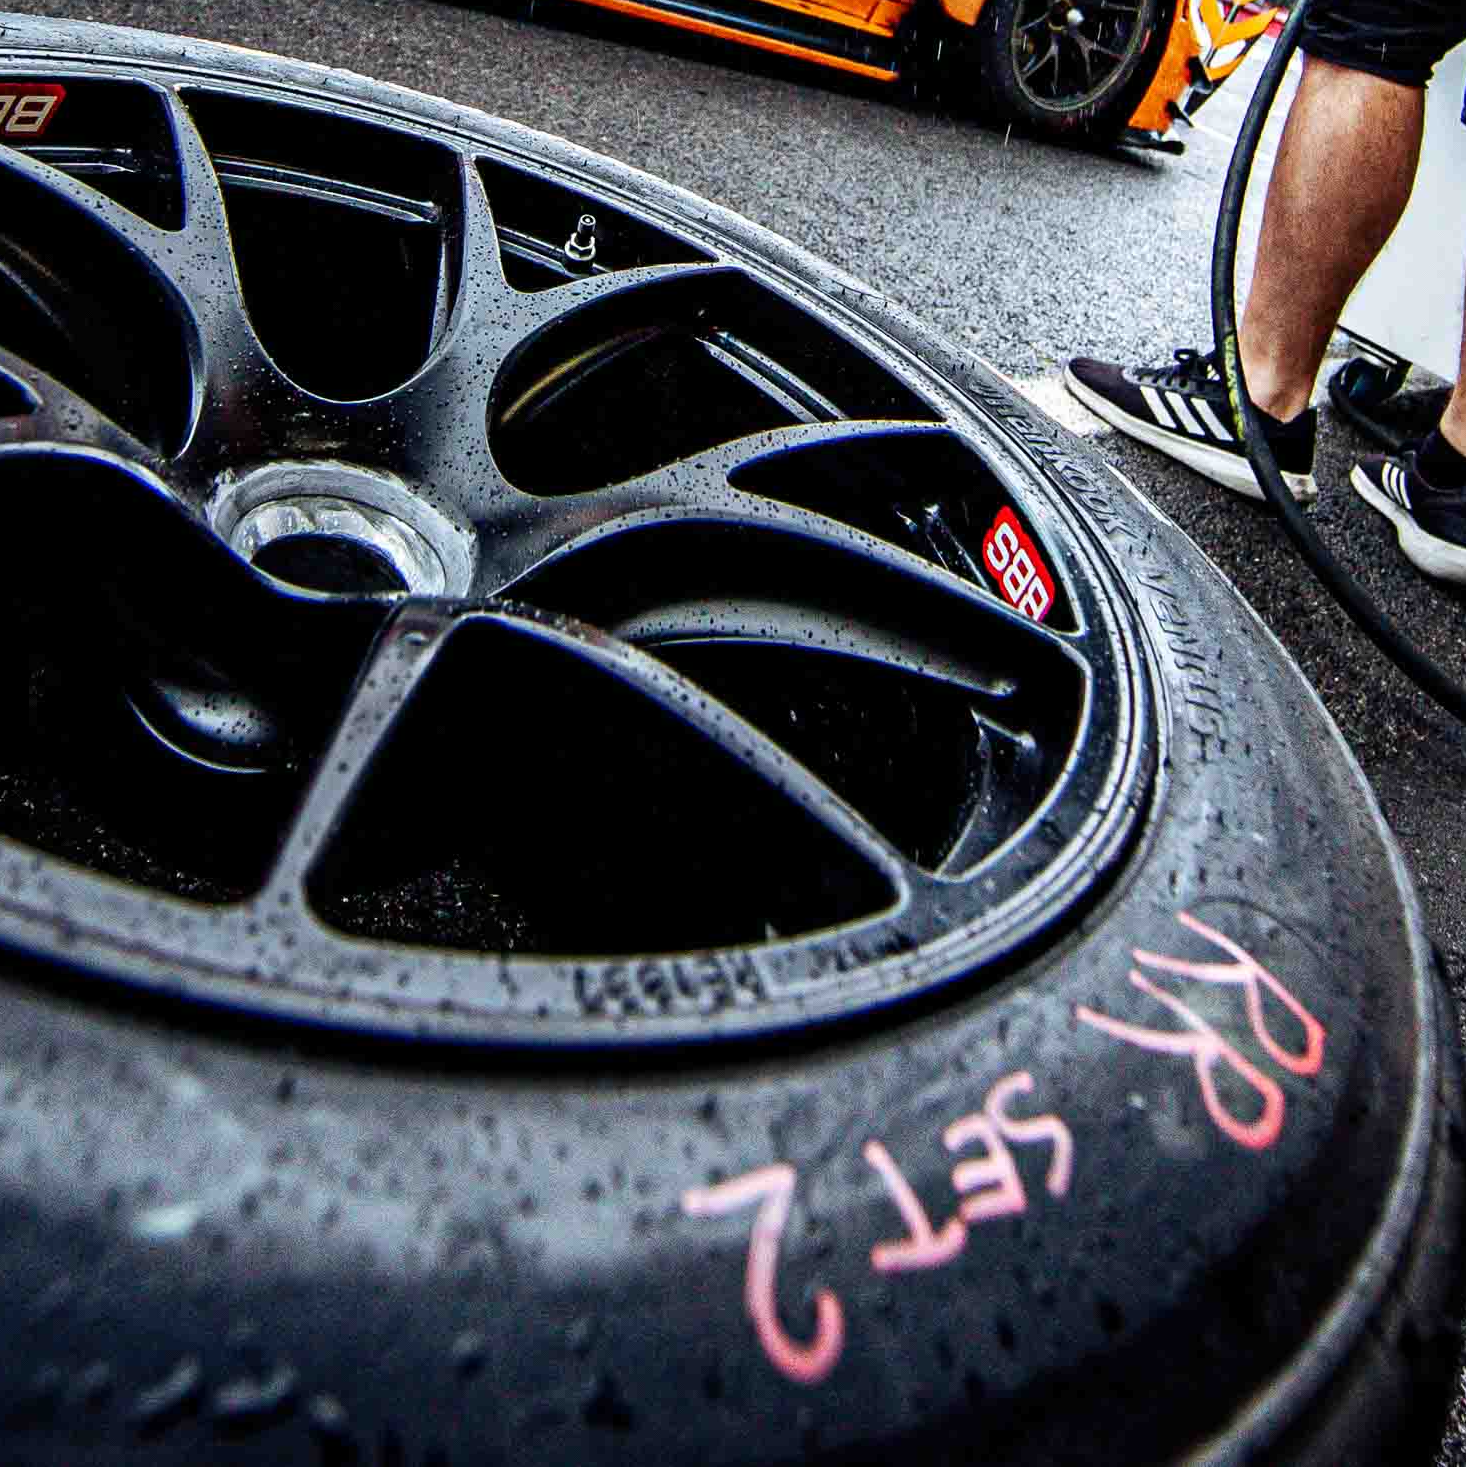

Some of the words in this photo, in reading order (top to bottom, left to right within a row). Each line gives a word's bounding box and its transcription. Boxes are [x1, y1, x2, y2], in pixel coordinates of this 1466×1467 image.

[1074, 909, 1328, 1151] RR
[681, 1162, 844, 1382] 2
[871, 1070, 1074, 1272] SET
